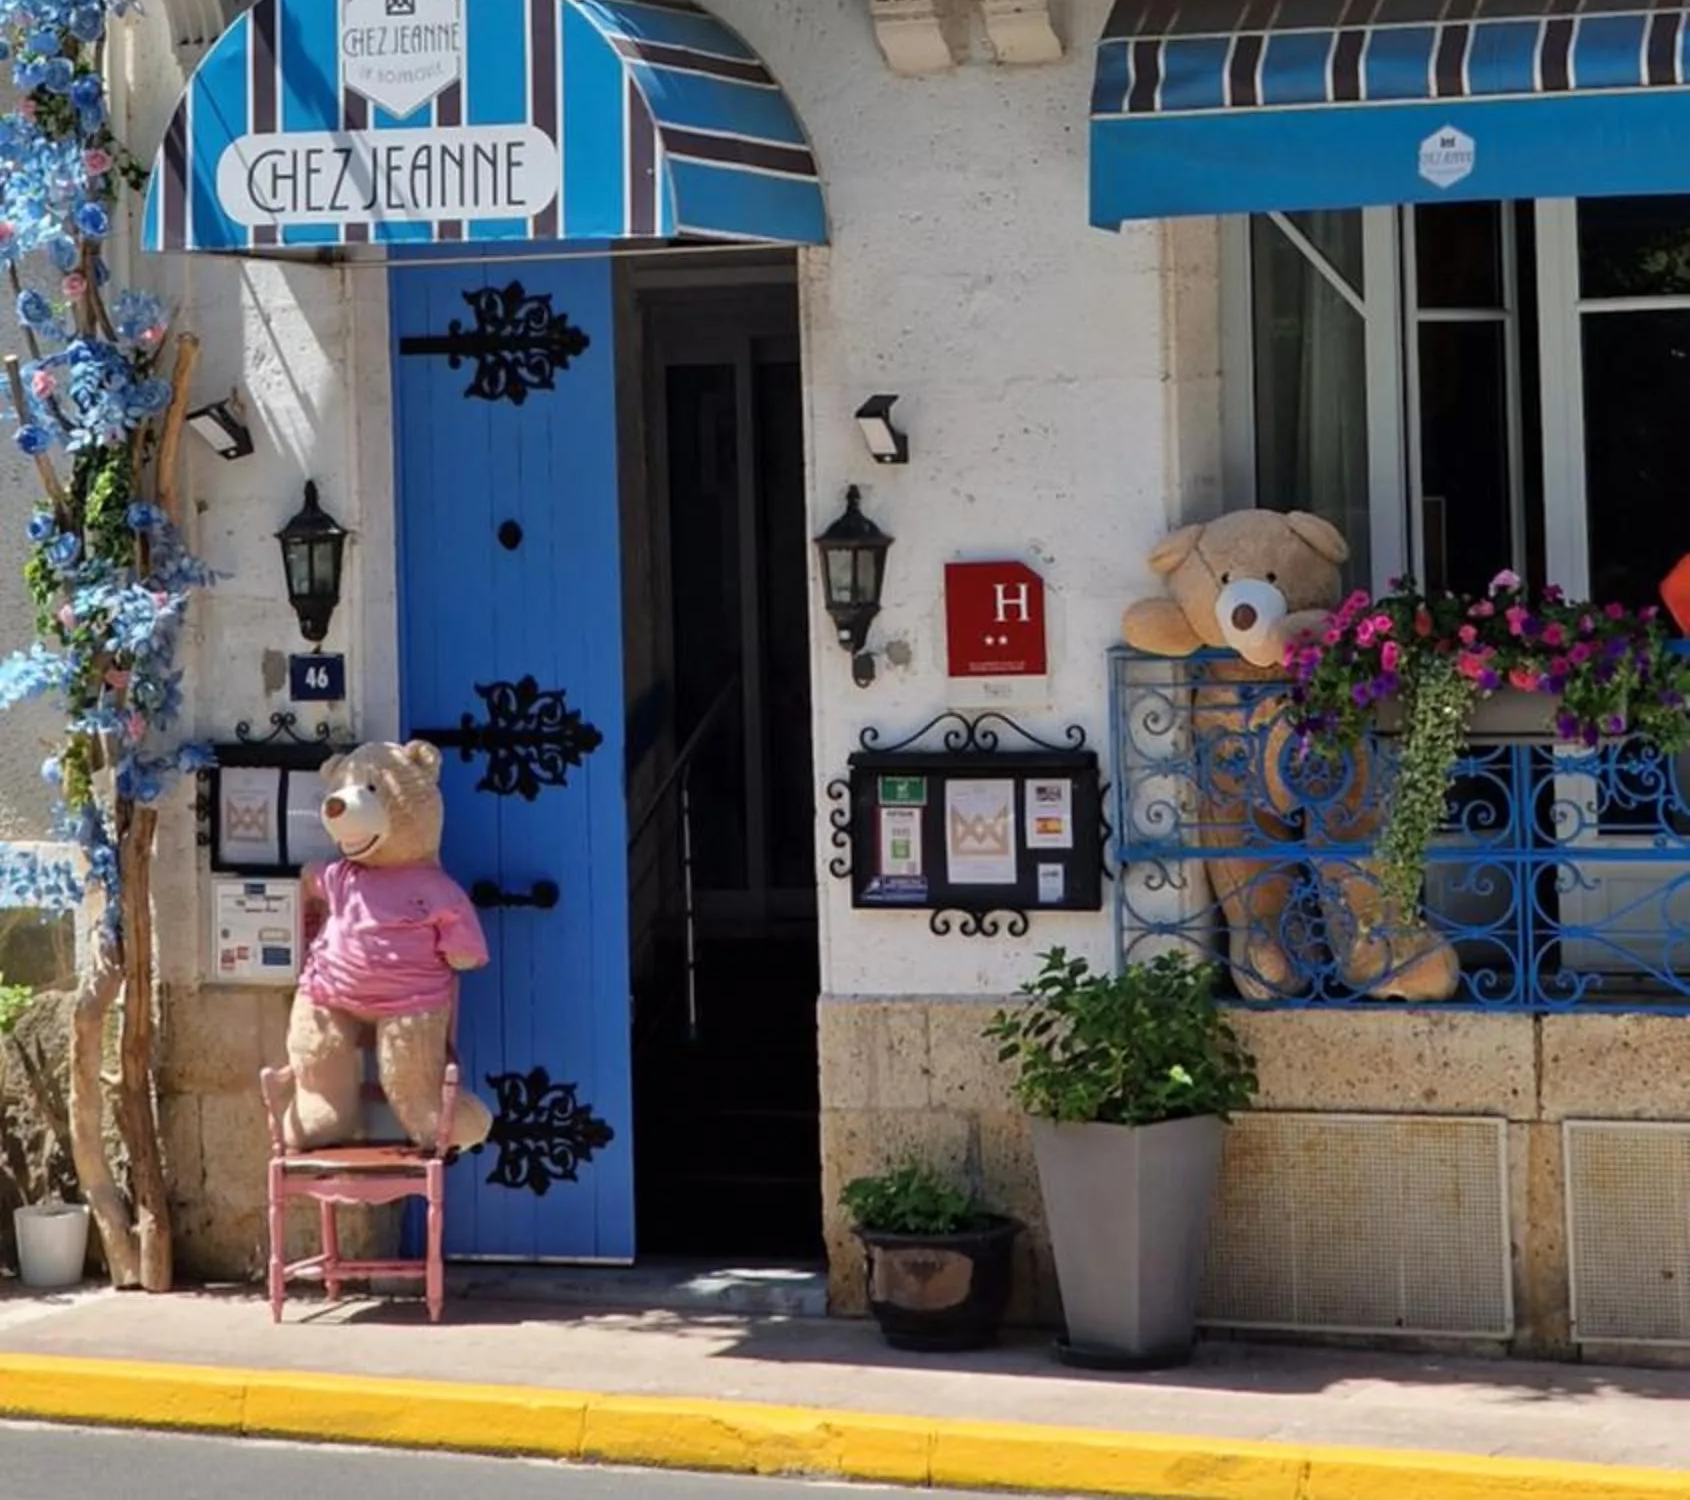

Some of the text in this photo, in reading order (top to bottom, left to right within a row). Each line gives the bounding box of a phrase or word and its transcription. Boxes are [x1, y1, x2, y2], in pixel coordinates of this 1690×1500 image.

[343, 22, 460, 57] CHEZ JEANNE
[247, 141, 526, 213] CHEZ JEANNE
[993, 583, 1030, 622] H
[304, 666, 329, 689] 46
